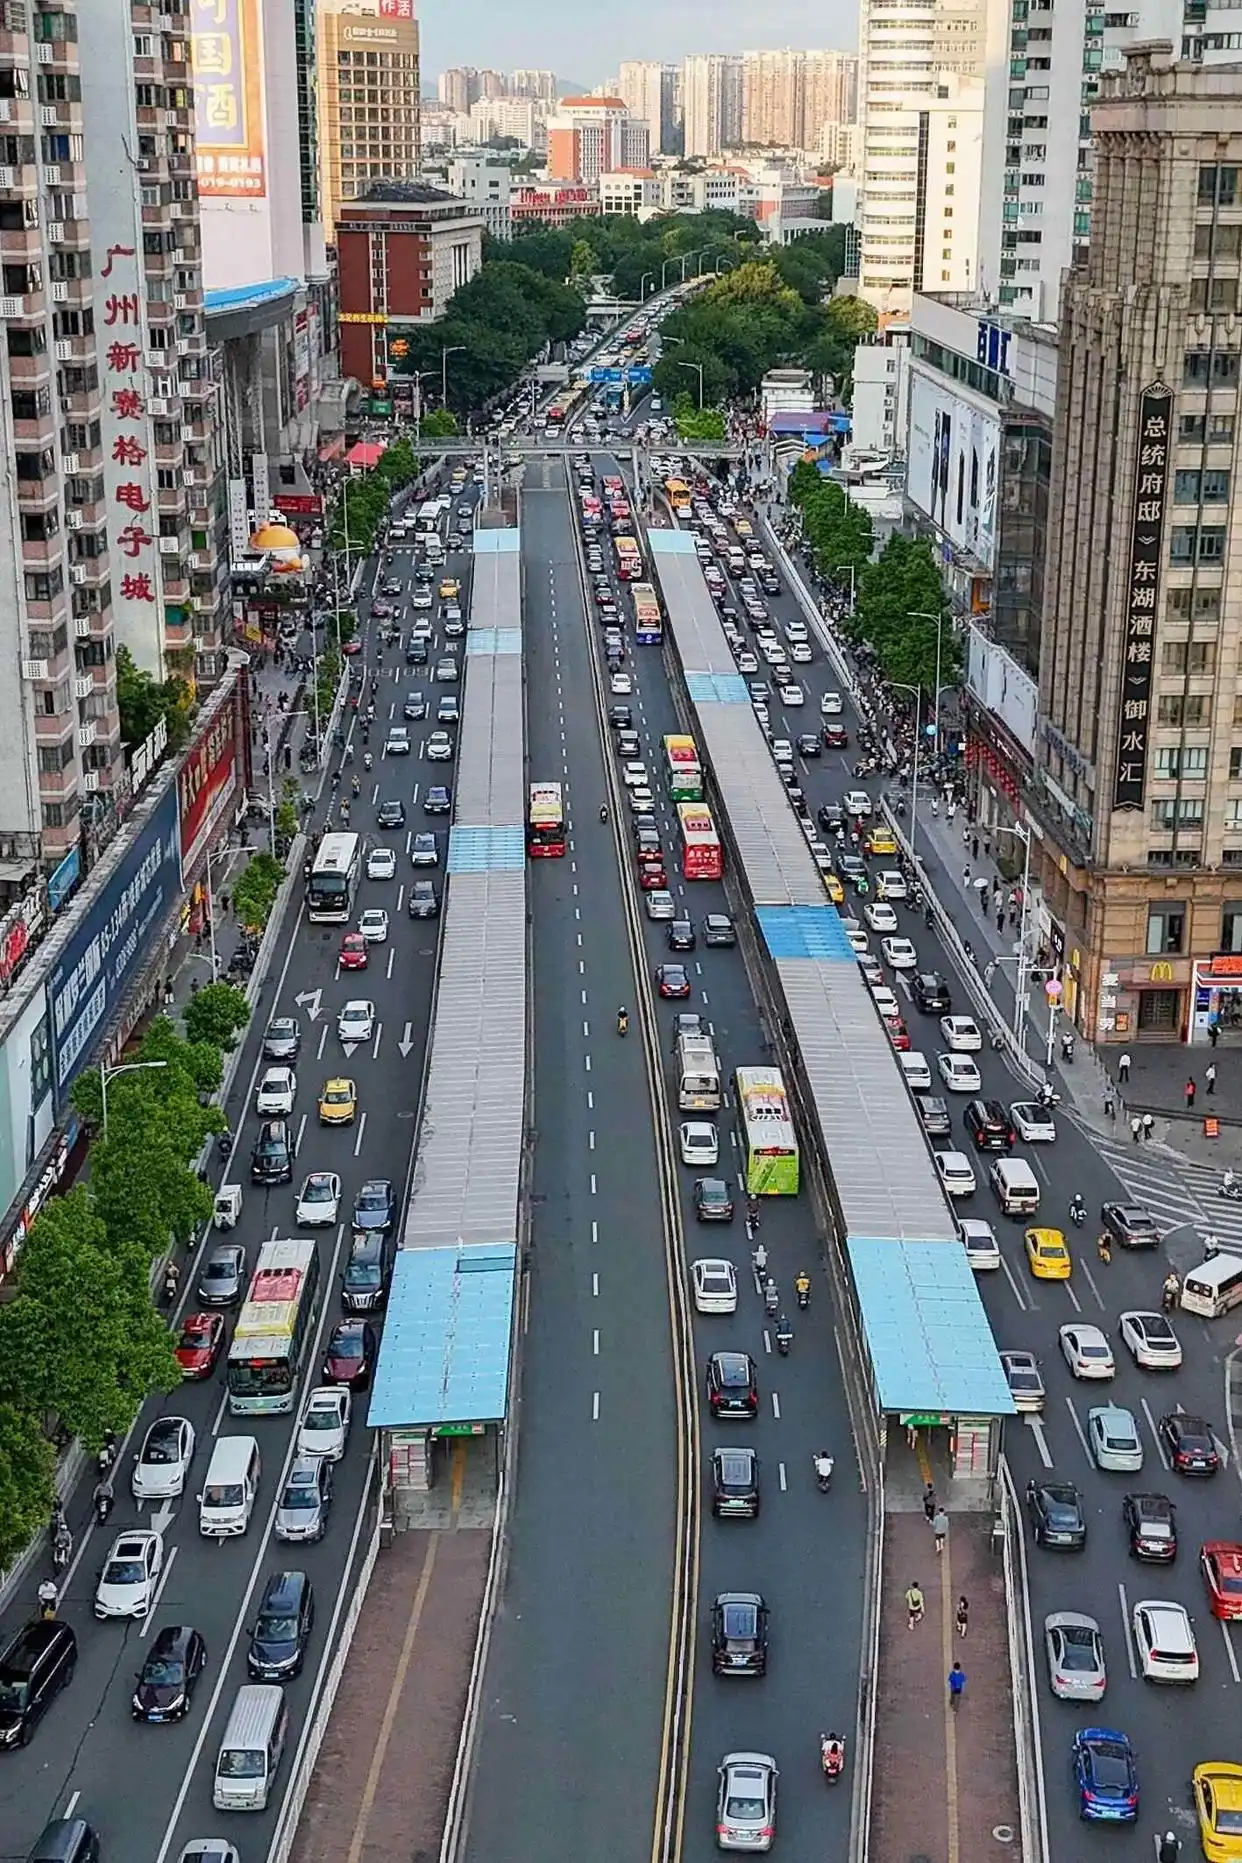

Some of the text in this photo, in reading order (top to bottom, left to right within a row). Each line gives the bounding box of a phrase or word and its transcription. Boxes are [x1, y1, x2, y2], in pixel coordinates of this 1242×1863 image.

[100, 244, 155, 602] 广州新赛格电子城
[1119, 415, 1167, 784] 总统府邸 东湖酒楼 御水汇
